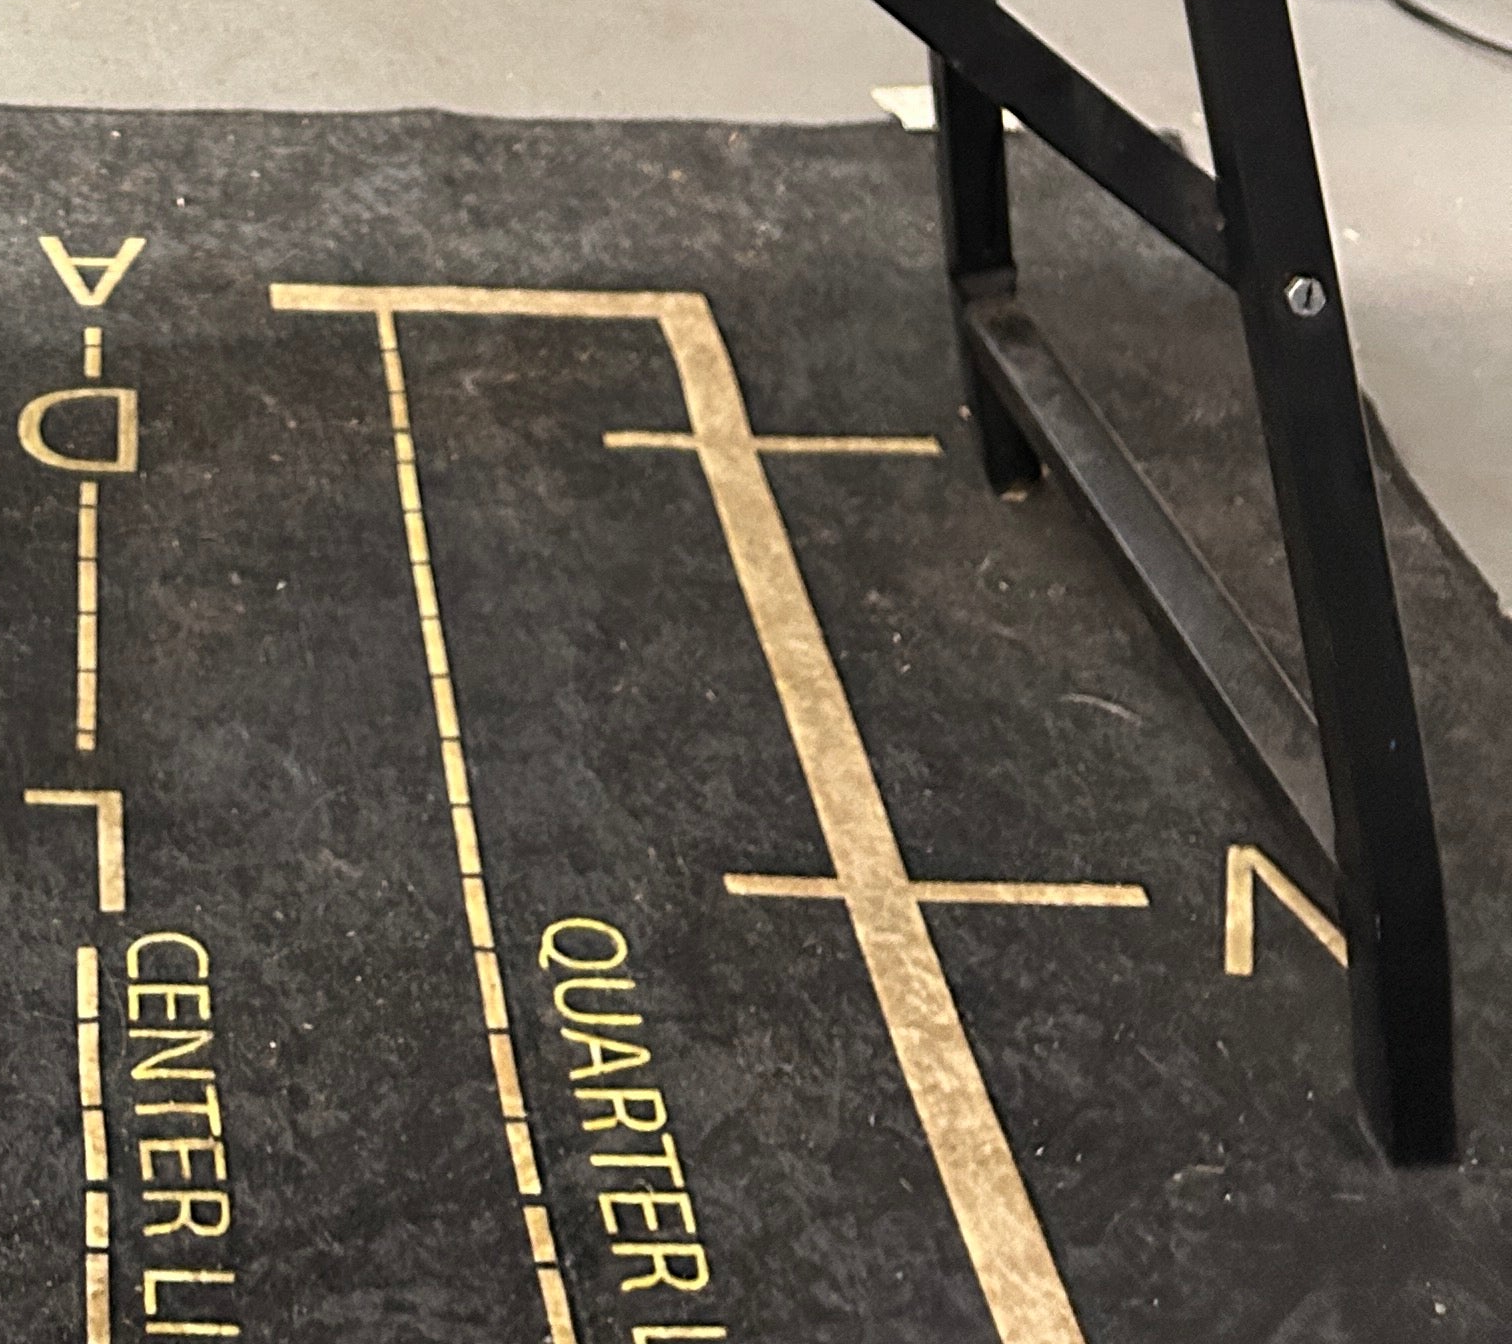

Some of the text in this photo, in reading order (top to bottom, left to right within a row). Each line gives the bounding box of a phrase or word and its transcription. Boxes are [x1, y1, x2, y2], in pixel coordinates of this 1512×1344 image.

[40, 234, 146, 306] A
[17, 387, 138, 473] D
[126, 931, 231, 1238] CENTER
[538, 916, 711, 1293] QUARTER
